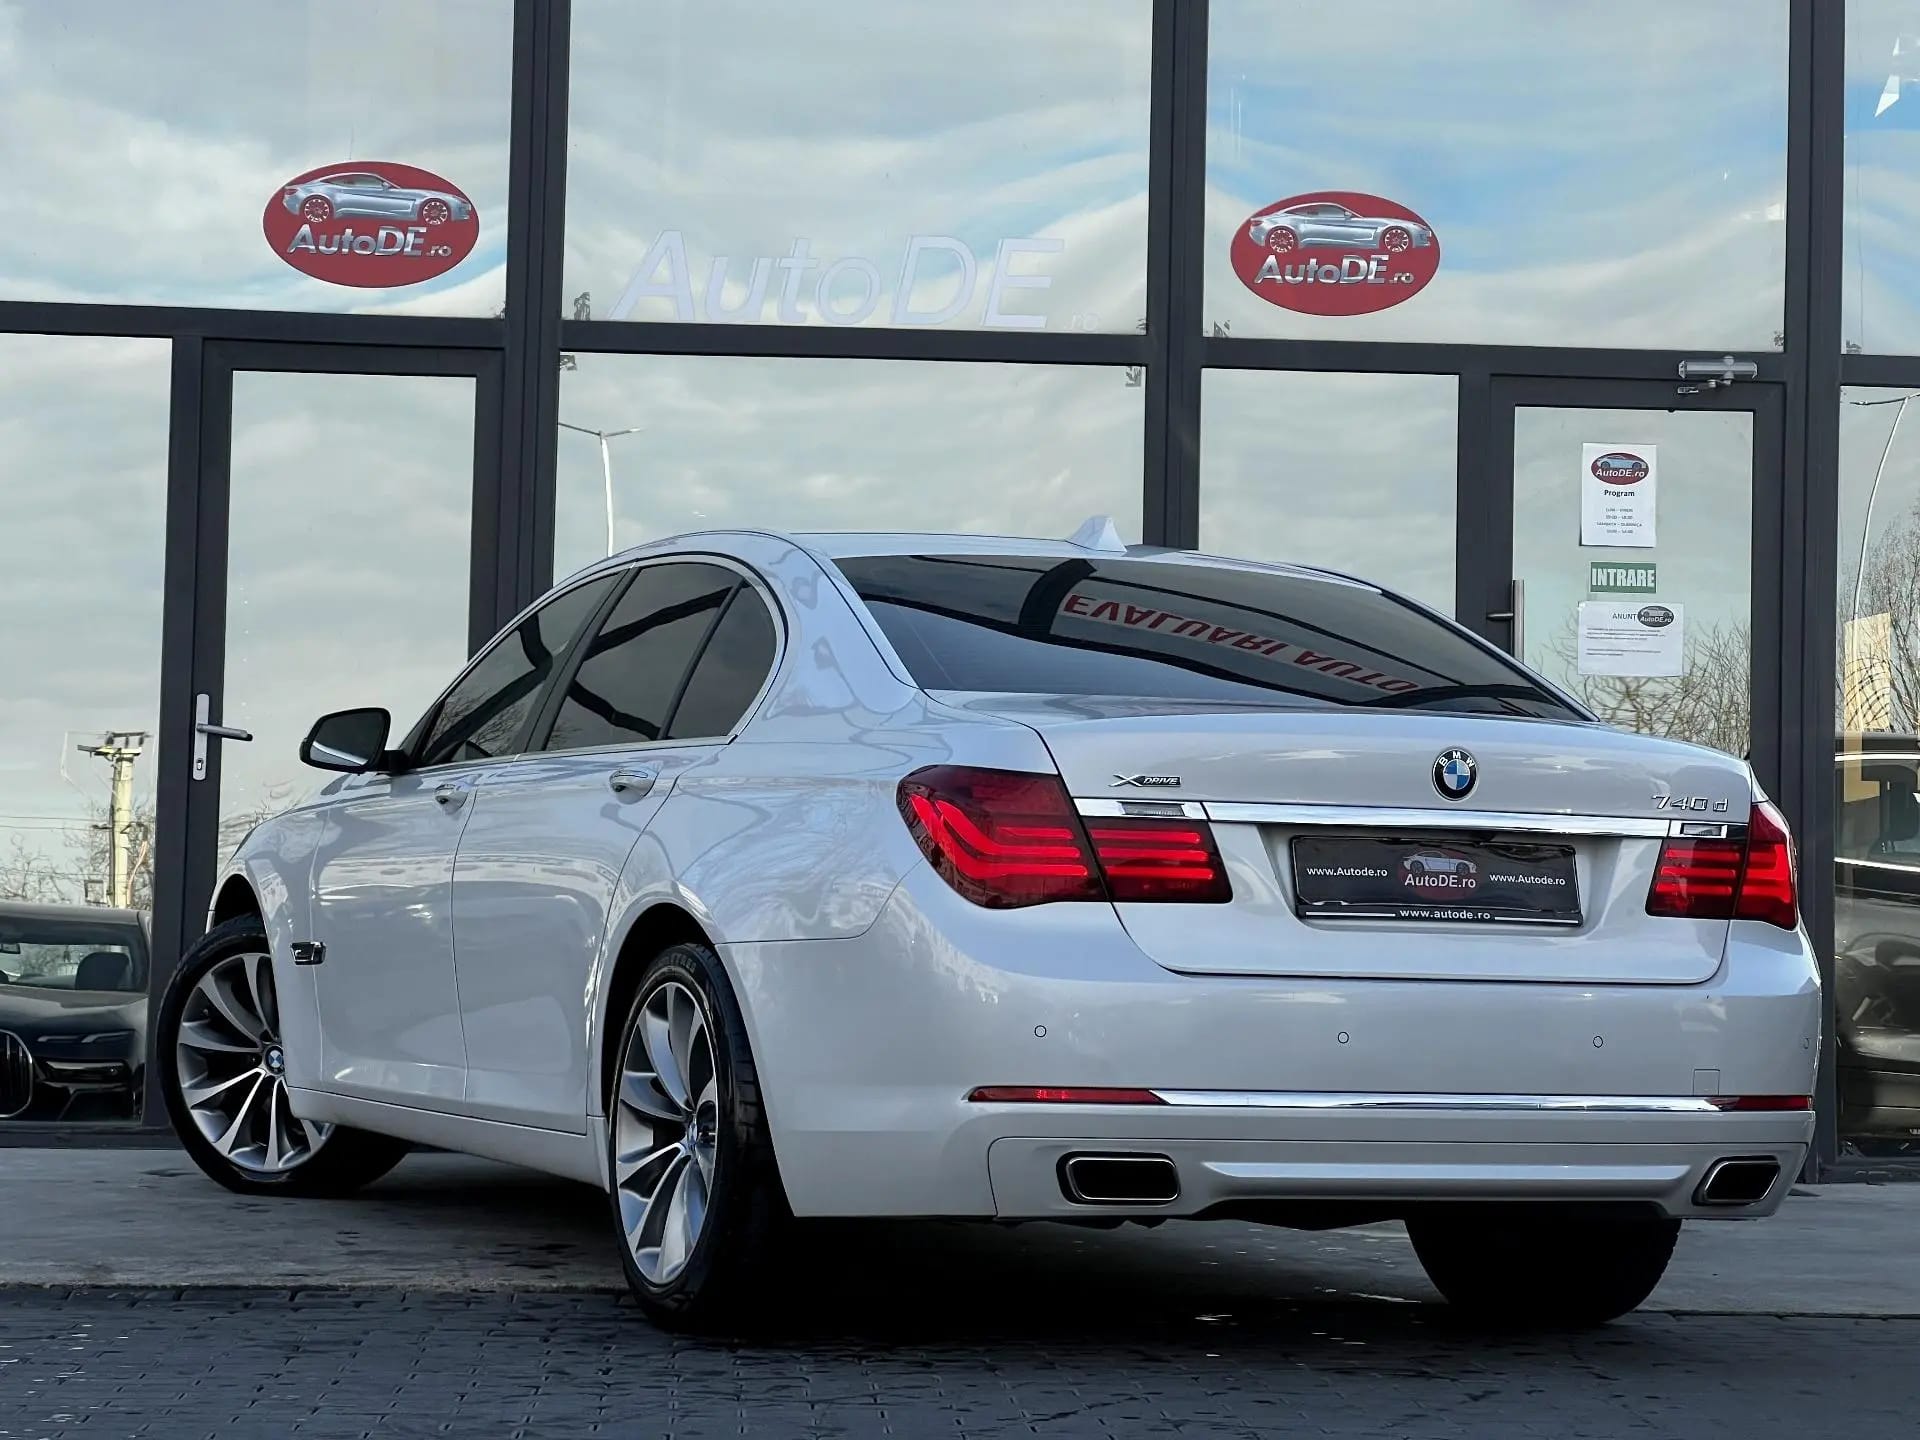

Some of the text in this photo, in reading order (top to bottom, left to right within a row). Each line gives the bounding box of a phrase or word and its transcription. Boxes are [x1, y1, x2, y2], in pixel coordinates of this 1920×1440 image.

[1604, 489, 1635, 498] Program
[1591, 568, 1655, 588] INTRARE
[1438, 750, 1475, 767] BMW
[1651, 794, 1728, 812] 740 d
[1306, 866, 1388, 877] www.Autode.ro
[1404, 873, 1476, 889] AutoDE.ro
[1489, 874, 1566, 886] www.Autode.ro
[1399, 909, 1491, 920] www.autode.ro
